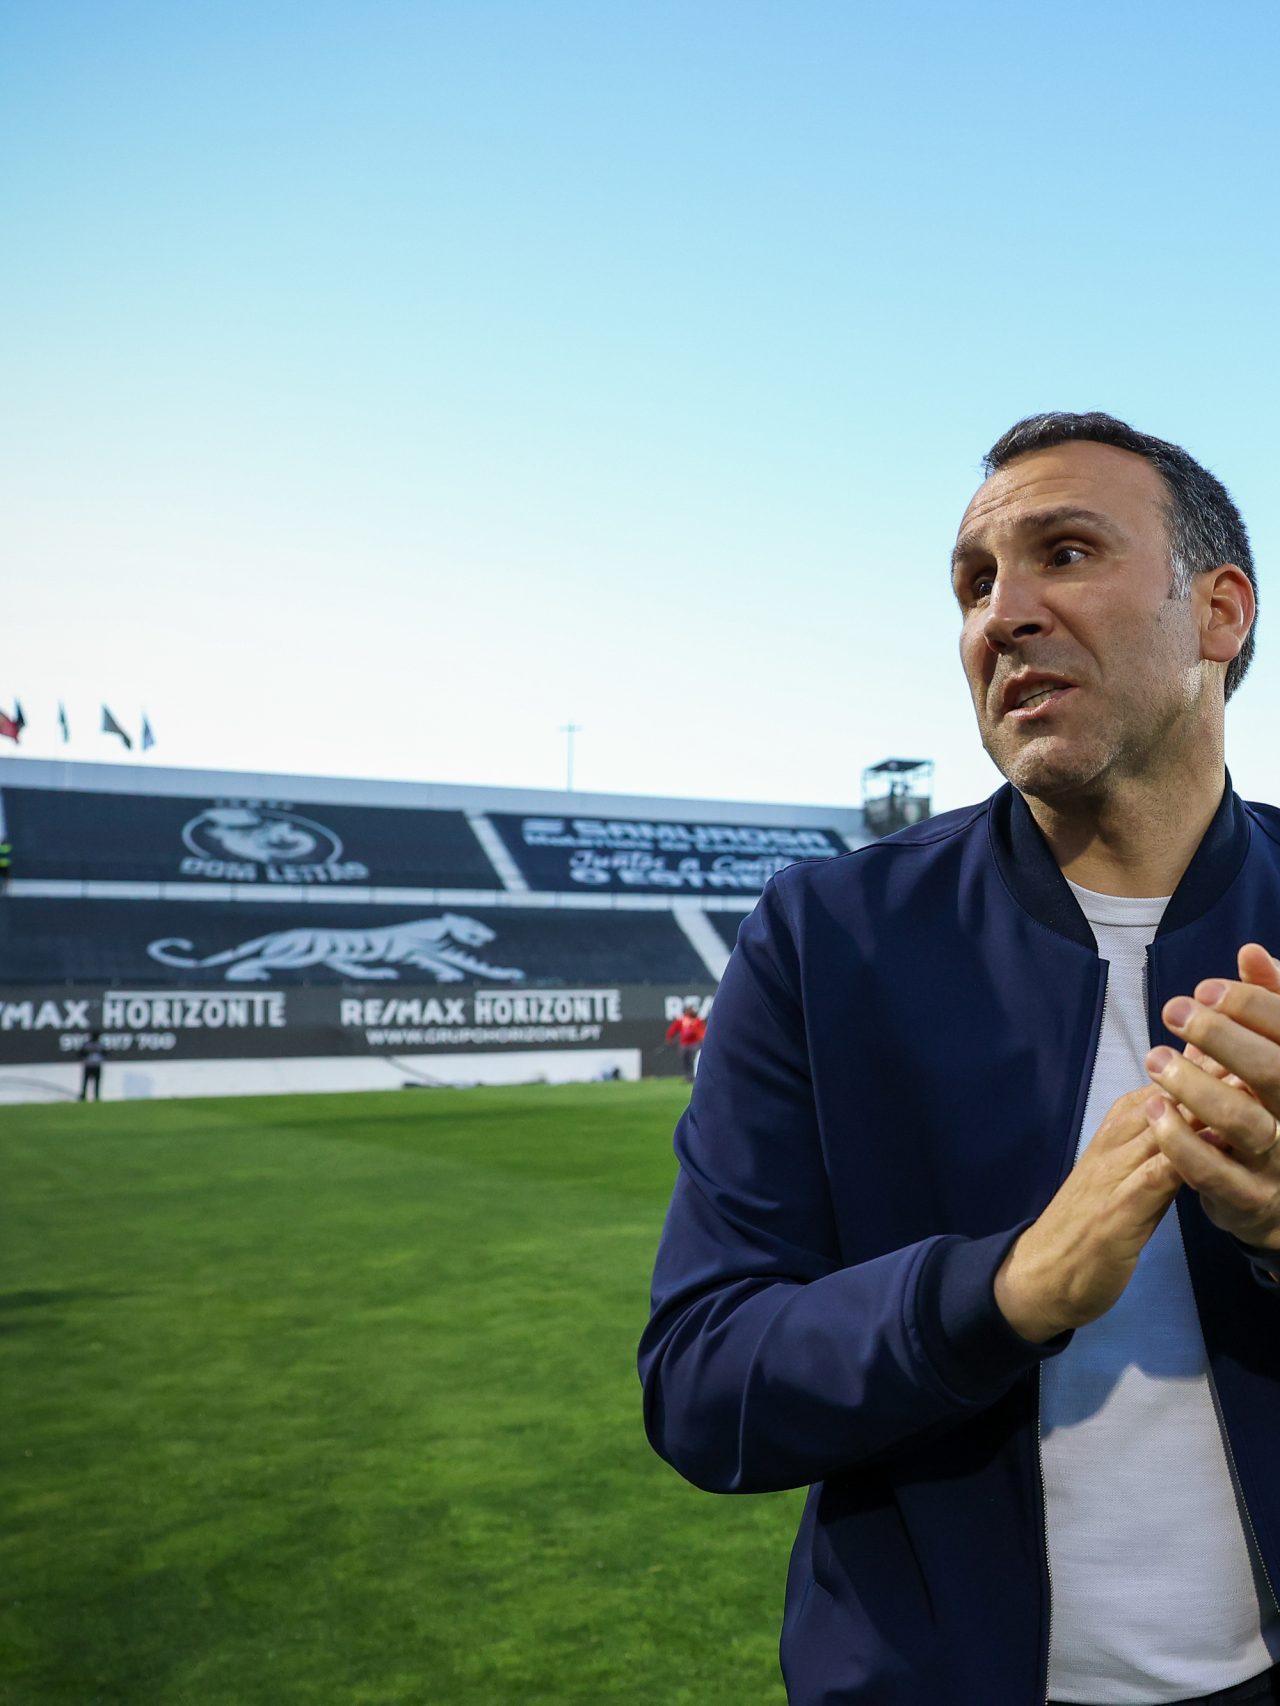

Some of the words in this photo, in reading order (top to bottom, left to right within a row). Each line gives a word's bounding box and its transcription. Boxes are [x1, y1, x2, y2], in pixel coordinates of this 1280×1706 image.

[0, 1000, 90, 1030] MAX
[102, 990, 286, 1029] HORIZONTE
[339, 998, 466, 1027] RE/MAX
[474, 989, 622, 1022] HORIZONTE
